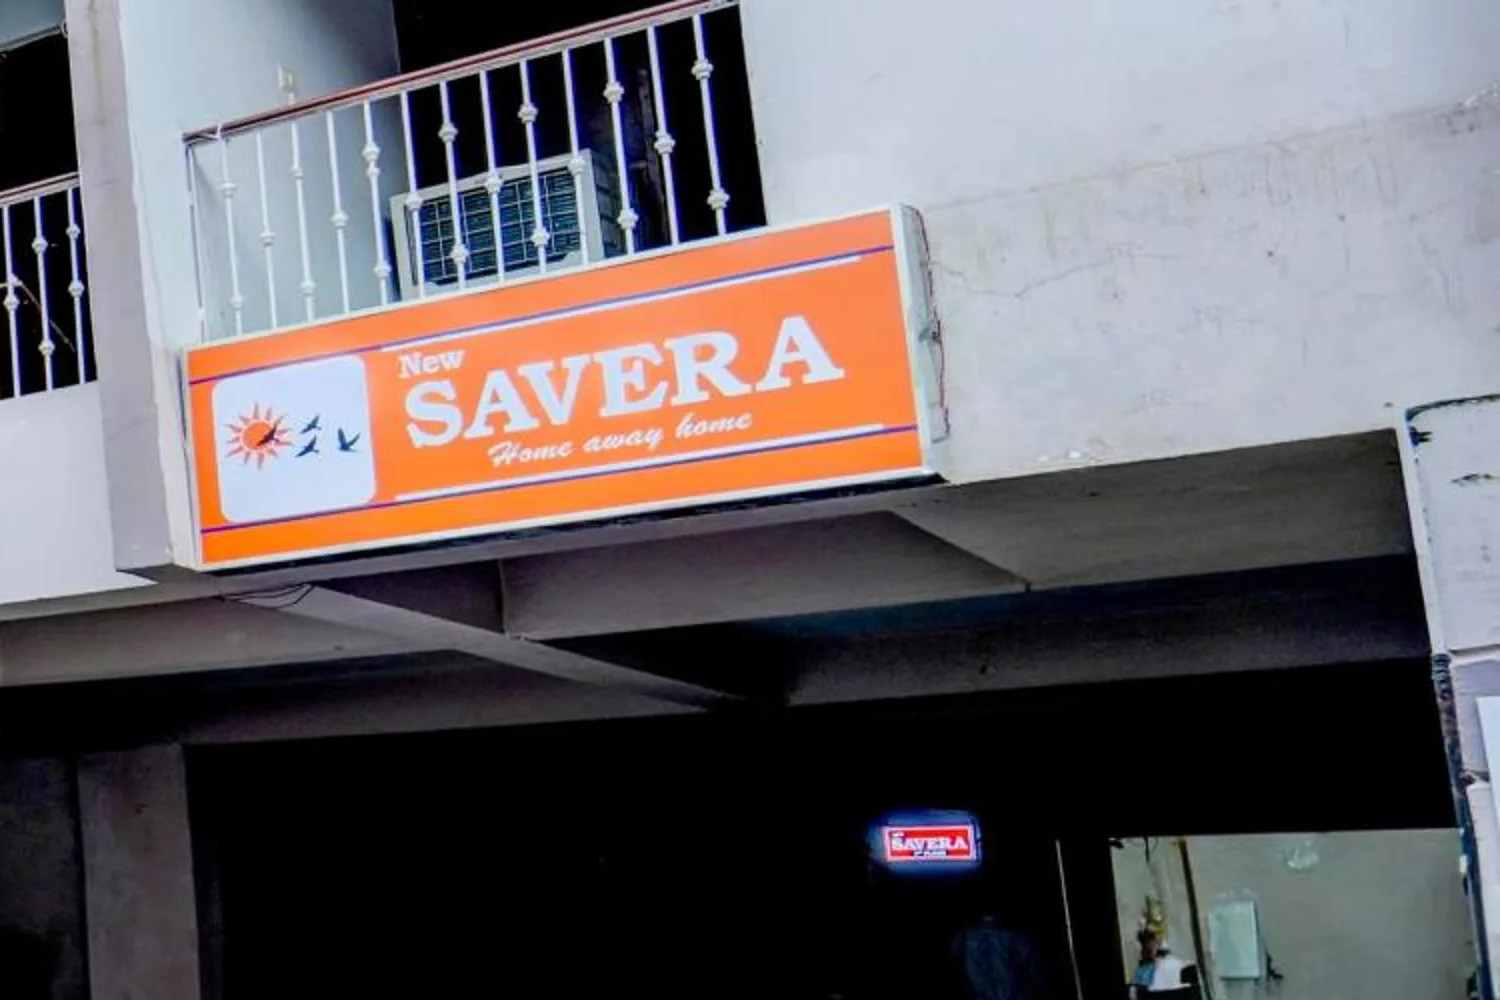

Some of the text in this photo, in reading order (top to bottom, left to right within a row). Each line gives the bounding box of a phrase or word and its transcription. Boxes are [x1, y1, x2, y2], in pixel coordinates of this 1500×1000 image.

[398, 350, 466, 379] New
[404, 315, 846, 449] SAVERA
[487, 411, 753, 468] Home away home
